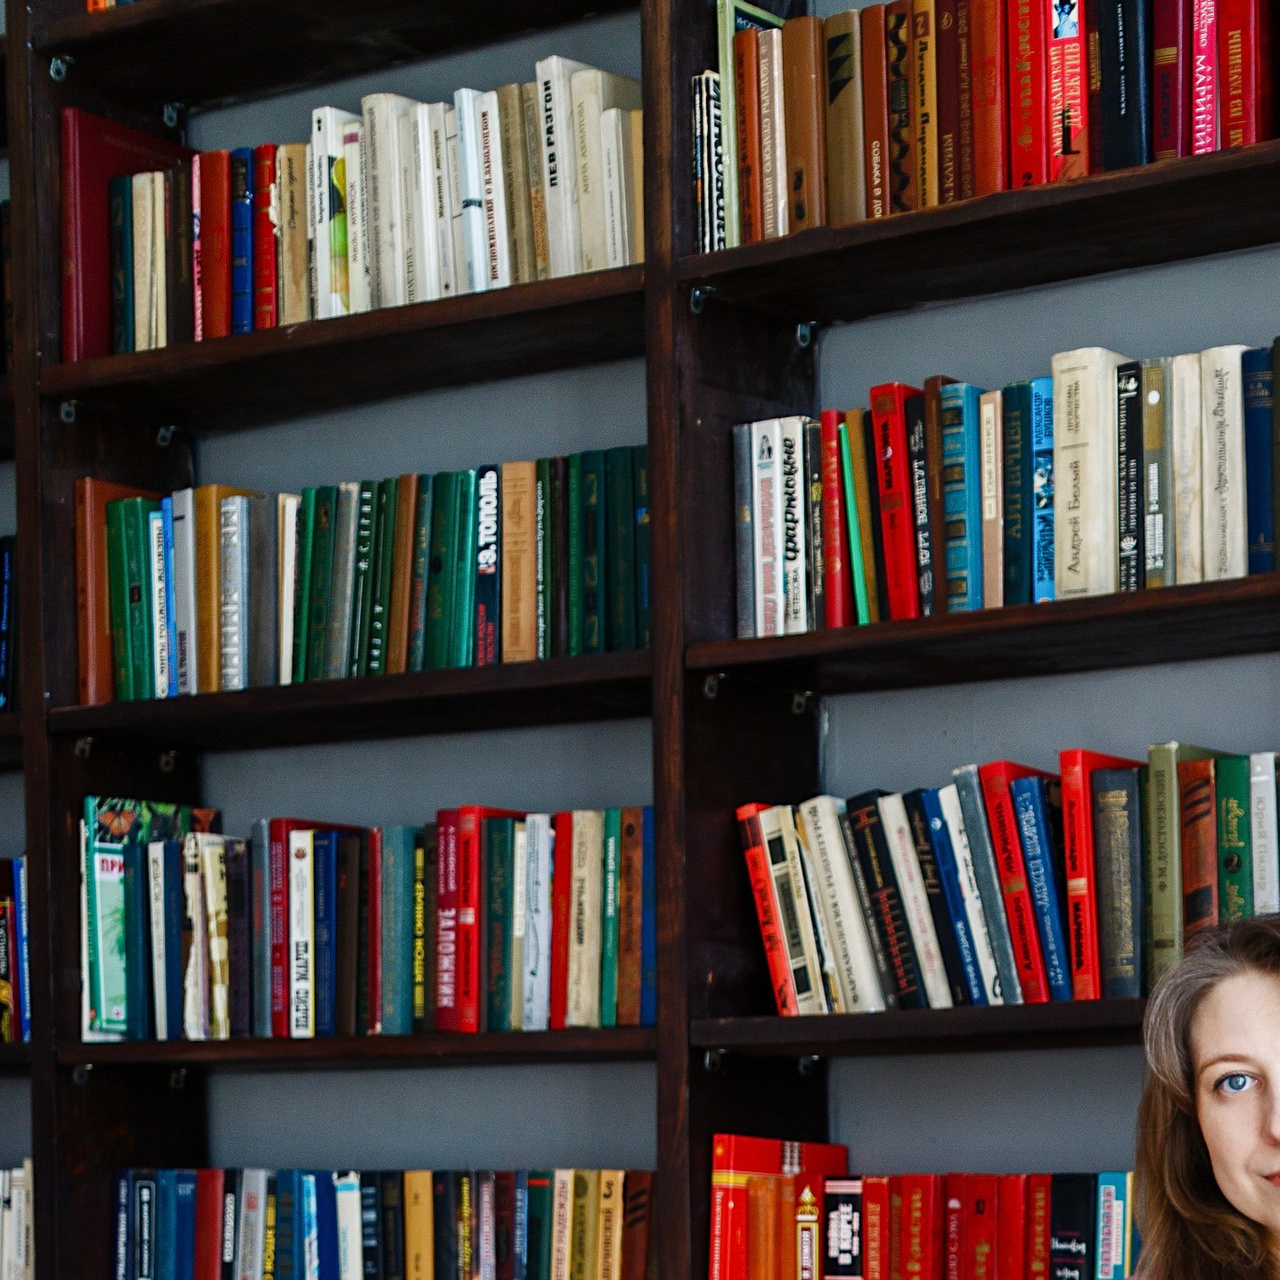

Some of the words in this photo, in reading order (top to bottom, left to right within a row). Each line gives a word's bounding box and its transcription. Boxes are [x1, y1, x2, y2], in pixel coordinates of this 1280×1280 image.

[1050, 44, 1063, 157] АМЕРИКАНСКИЙ
[1063, 43, 1083, 128] ДЕТЕКТИВ
[544, 80, 555, 146] РАЗГОН
[547, 151, 558, 186] ЛЕВ
[872, 141, 880, 185] СОБАКА
[874, 188, 881, 196] В
[1034, 391, 1043, 445] АЛЕКСАНДР
[1043, 397, 1053, 437] БУШКОВ
[913, 460, 928, 524] ВОННЕГУТ
[1069, 460, 1080, 510] Белый
[917, 531, 930, 564] КУРТ
[1068, 516, 1081, 574] Андрей
